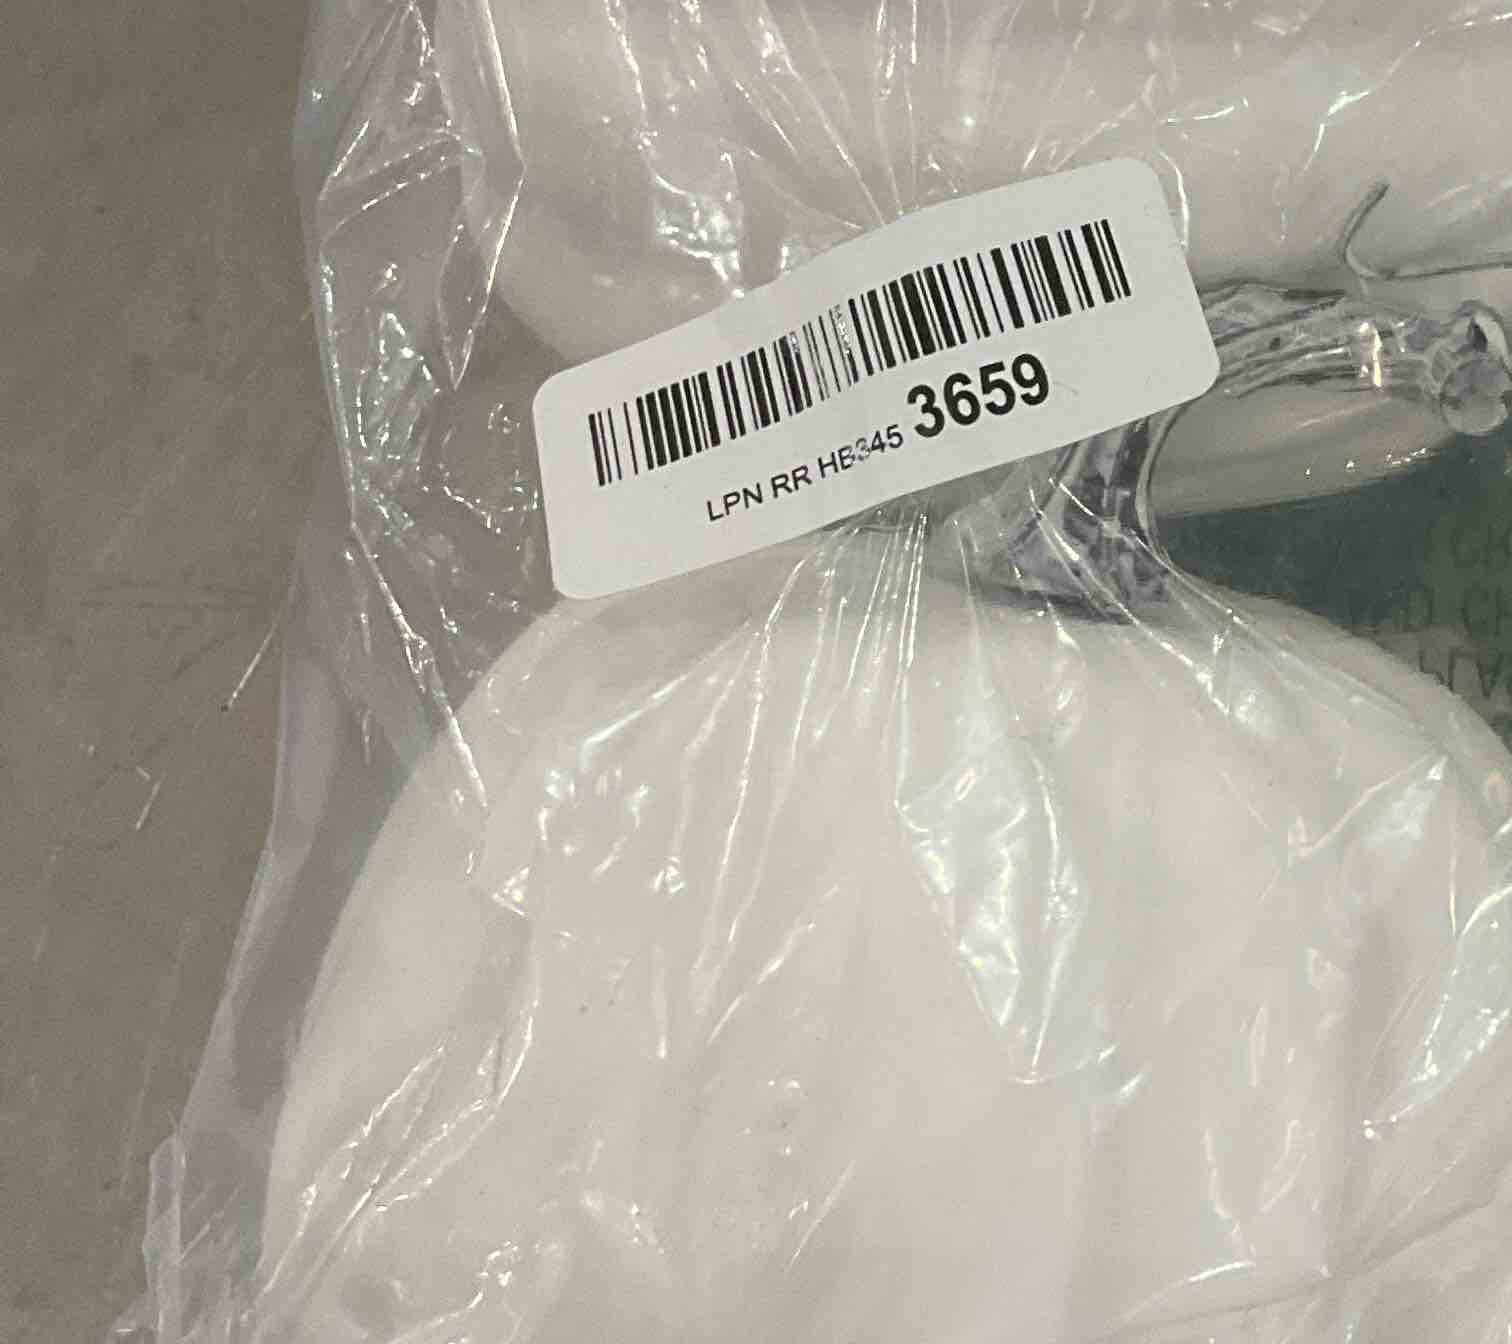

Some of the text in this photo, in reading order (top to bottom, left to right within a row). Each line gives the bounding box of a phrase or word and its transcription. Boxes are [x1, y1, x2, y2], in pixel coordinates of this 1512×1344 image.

[707, 353, 1049, 521] LPN RR HB345 3659
